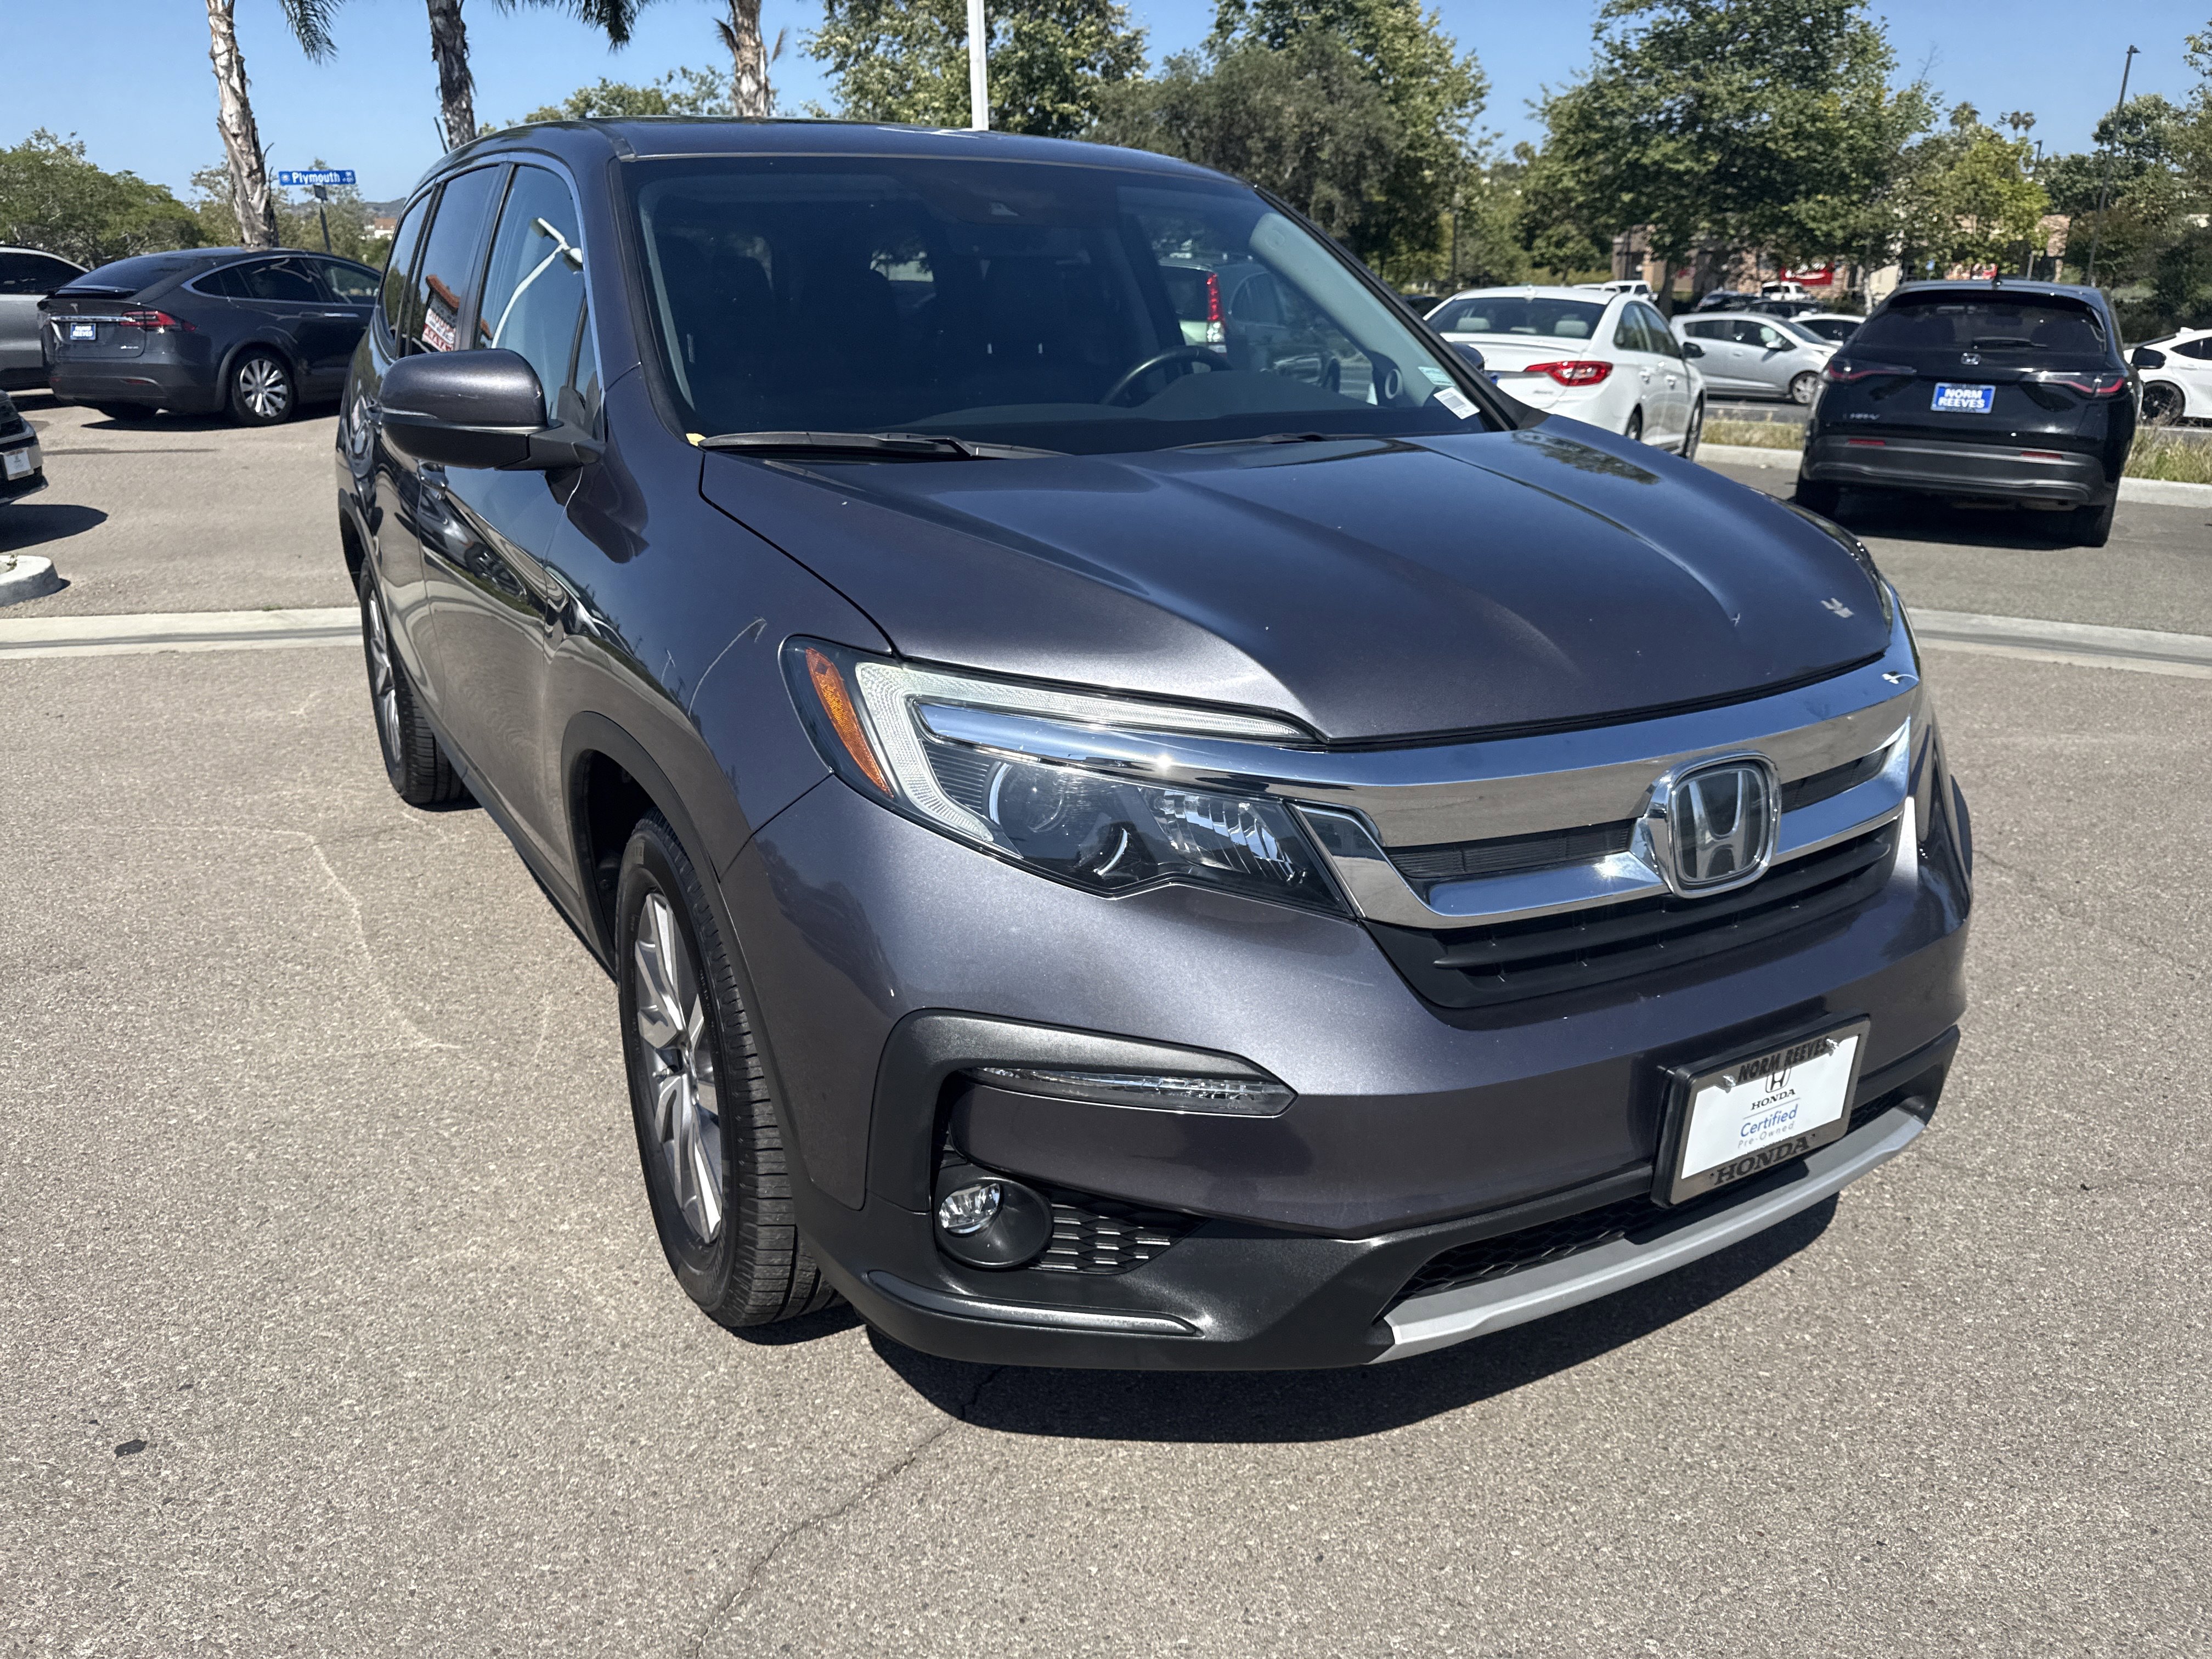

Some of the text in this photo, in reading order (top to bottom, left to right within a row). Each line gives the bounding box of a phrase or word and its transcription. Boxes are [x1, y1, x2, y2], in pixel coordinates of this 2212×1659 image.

[292, 172, 340, 184] Plymouth
[1938, 397, 1985, 408] REEVES
[1944, 388, 1983, 398] NORM
[1737, 1035, 1830, 1082] NORM REEVES
[1751, 1088, 1796, 1110] HONDA
[1740, 1104, 1798, 1137] Certified
[1737, 1121, 1795, 1149] Pre-Owned
[1714, 1136, 1809, 1186] HONDA
